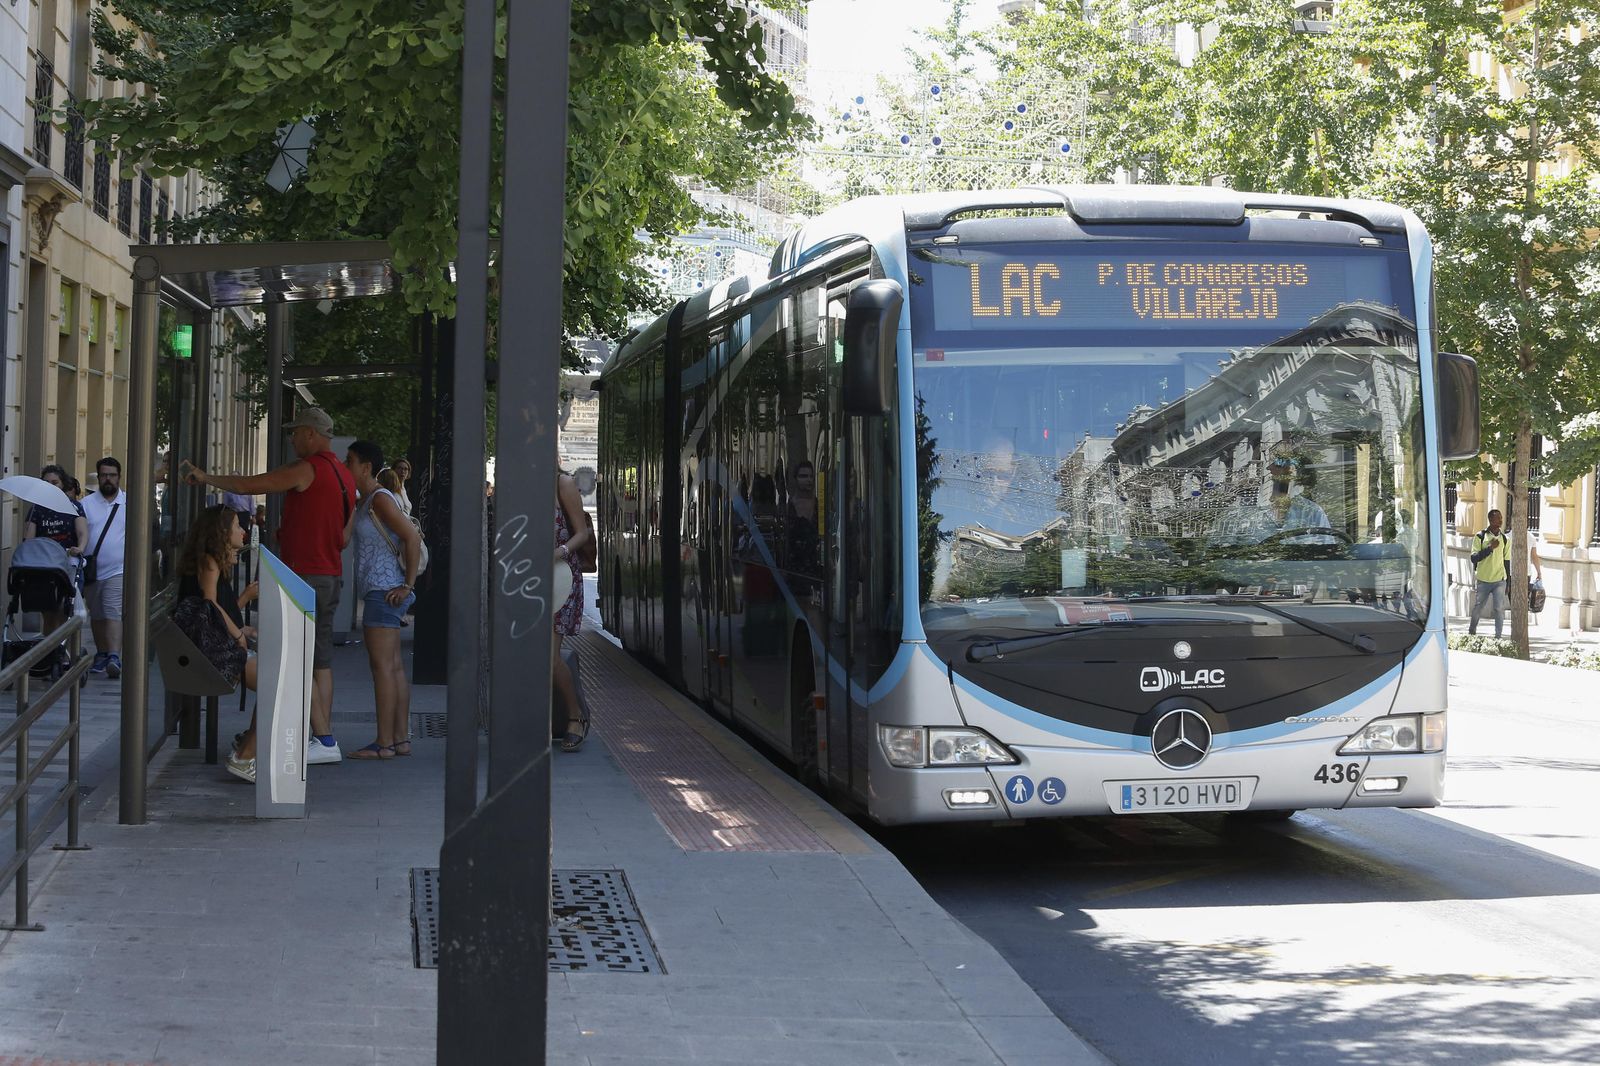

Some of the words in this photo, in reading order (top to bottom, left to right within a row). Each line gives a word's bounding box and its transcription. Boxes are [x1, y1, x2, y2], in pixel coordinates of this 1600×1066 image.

[1098, 263, 1119, 285] P.
[1126, 263, 1156, 285] DE
[1164, 263, 1309, 286] CONGRESOS
[970, 263, 1061, 316] LAC
[1132, 288, 1278, 319] VILLAREJO
[1180, 669, 1225, 685] LAC
[1314, 763, 1360, 784] 436
[1136, 785, 1189, 806] 3120
[1197, 784, 1237, 805] HVD
